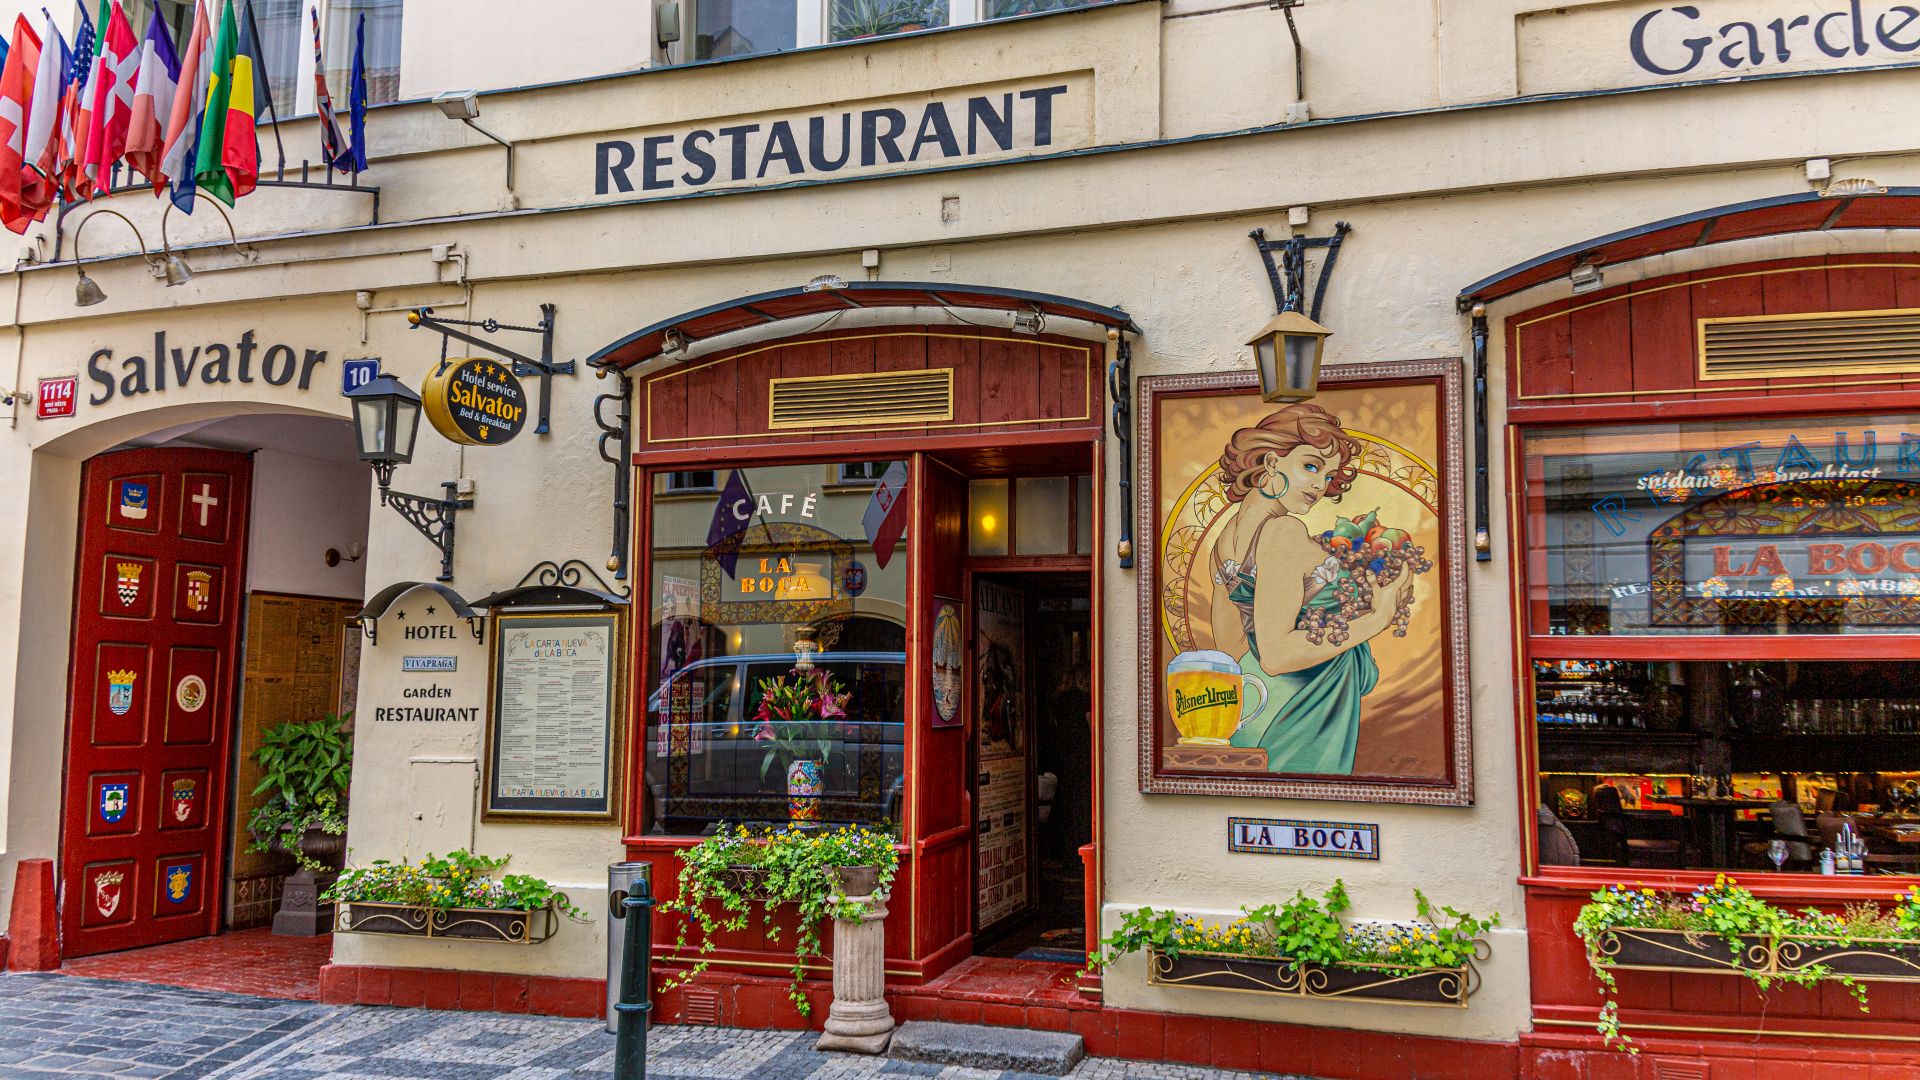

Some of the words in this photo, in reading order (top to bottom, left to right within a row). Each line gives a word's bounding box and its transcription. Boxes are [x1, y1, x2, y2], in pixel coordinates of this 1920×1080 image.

[595, 85, 1068, 195] RESTAURANT
[87, 329, 328, 406] Salvator
[350, 366, 370, 386] 10
[43, 382, 71, 400] 1114
[461, 370, 485, 387] Hotel
[487, 381, 517, 398] service
[451, 380, 522, 421] Salvator
[460, 407, 473, 419] Bed
[474, 412, 480, 421] &
[481, 414, 512, 431] Breakfast
[732, 493, 816, 520] CAFÉ
[759, 557, 792, 574] LA
[1712, 542, 1791, 577] LA
[741, 577, 813, 593] BOCA
[405, 625, 457, 639] HOTEL
[524, 640, 535, 648] LA
[536, 640, 560, 648] CARTA
[562, 639, 588, 648] NUEVA
[545, 649, 555, 657] LA
[556, 649, 577, 657] BOCA
[405, 659, 453, 668] VIVAPRAGA
[1175, 688, 1207, 718] Pilsner
[375, 708, 479, 722] RESTAURANT
[512, 788, 534, 796] CARTA
[536, 788, 558, 796] NUEVA
[570, 789, 579, 797] LA
[581, 789, 600, 797] BOCA
[1241, 825, 1273, 847] LA
[1294, 827, 1365, 851] BOCA
